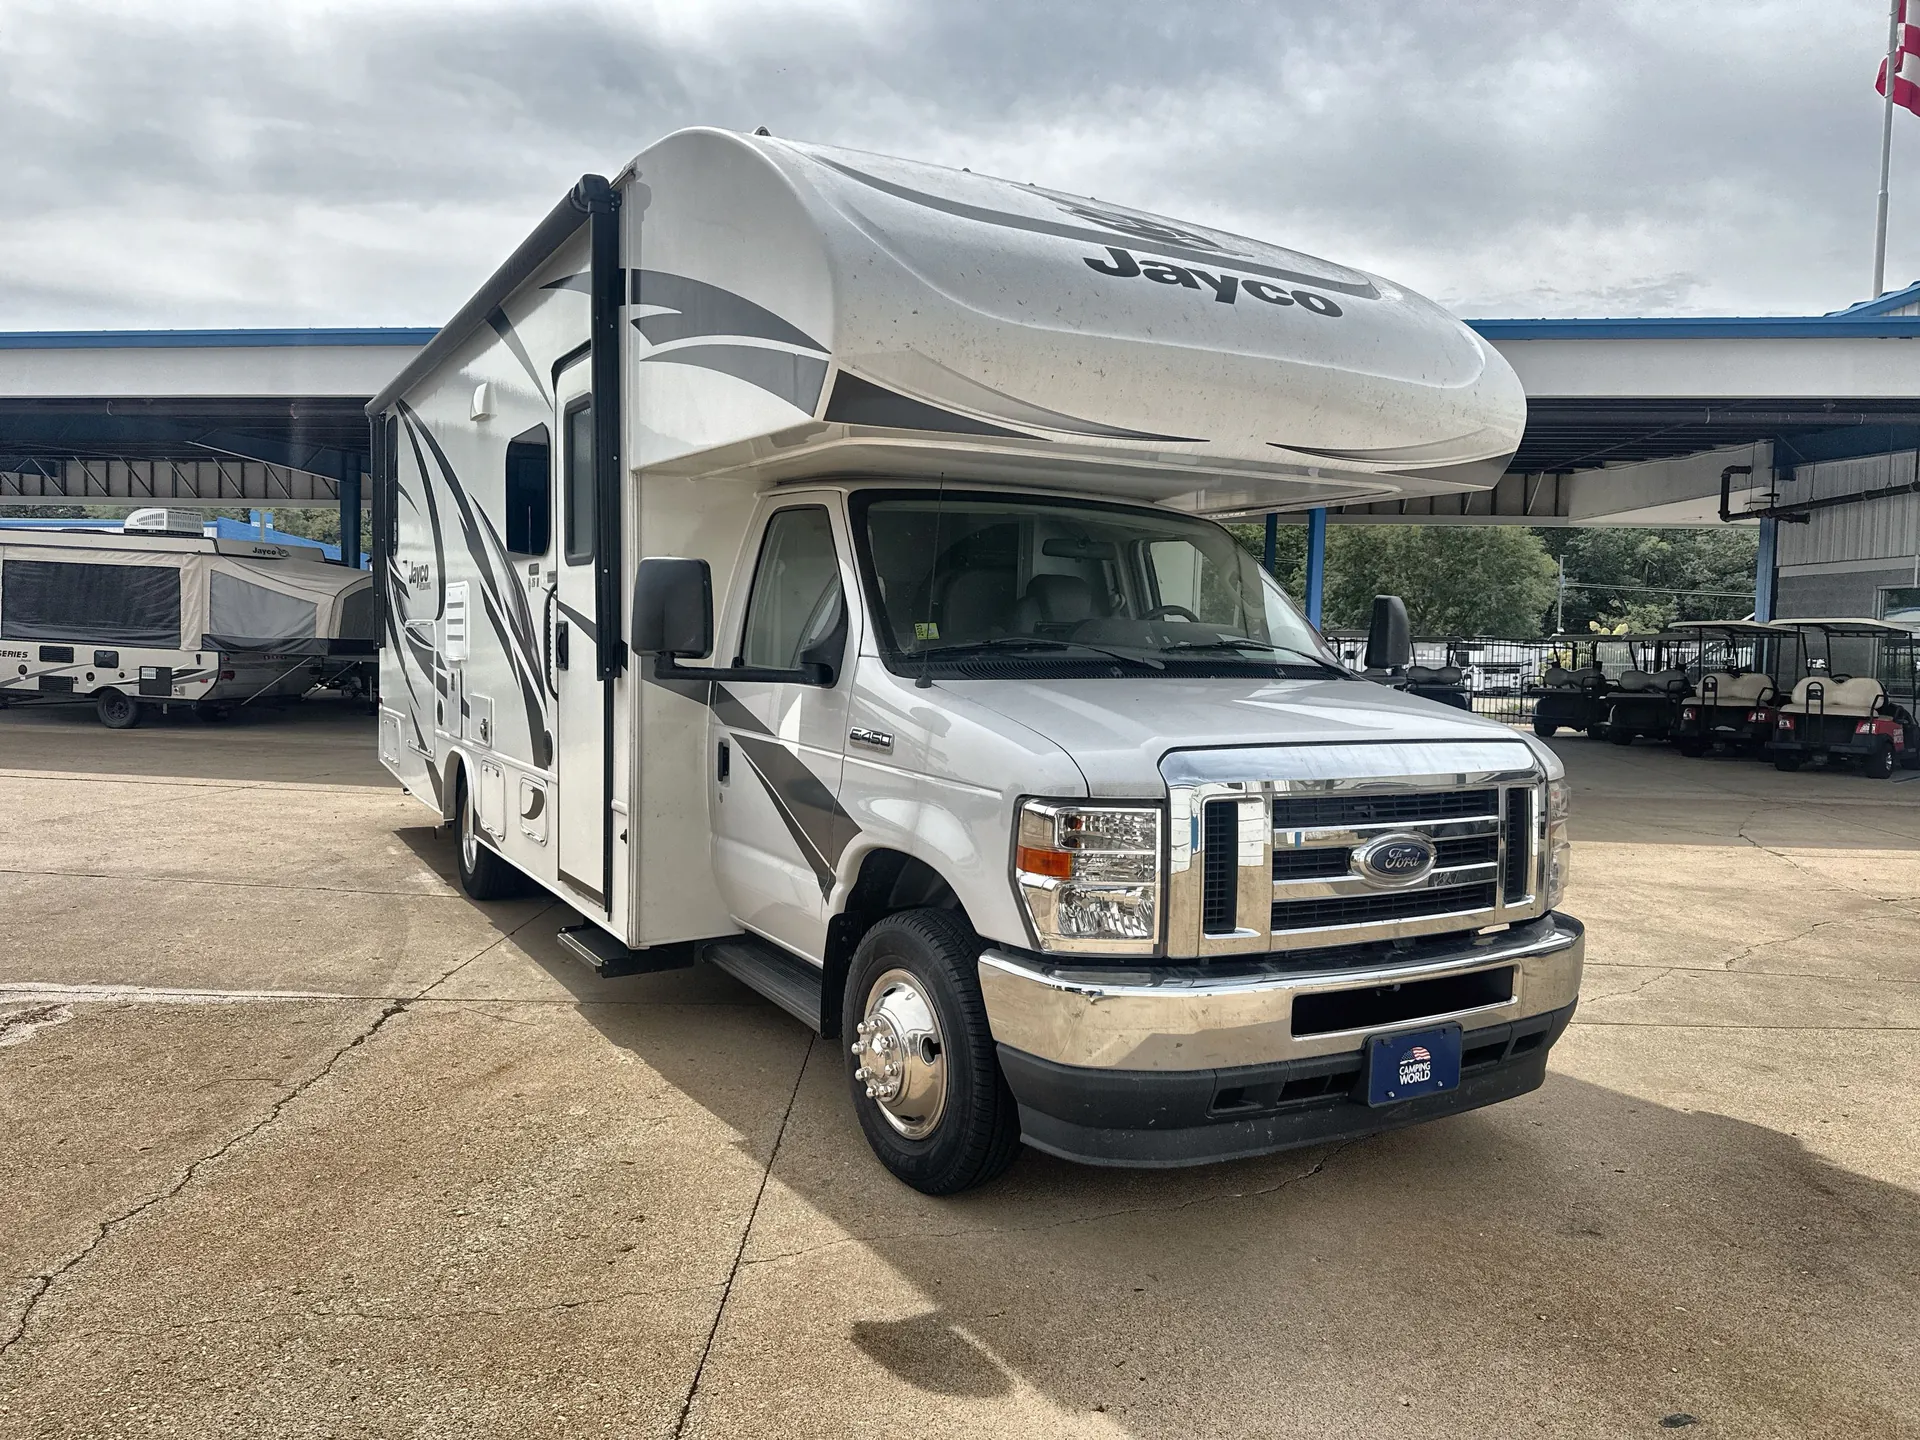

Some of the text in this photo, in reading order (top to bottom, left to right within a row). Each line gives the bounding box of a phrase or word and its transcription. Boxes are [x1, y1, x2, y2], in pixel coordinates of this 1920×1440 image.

[1083, 246, 1344, 318] Jayco
[252, 547, 277, 556] Jayco
[409, 561, 429, 588] Jayco
[1385, 847, 1421, 869] Ford
[1399, 1061, 1431, 1075] CAMPING
[1399, 1070, 1431, 1085] WORLD
